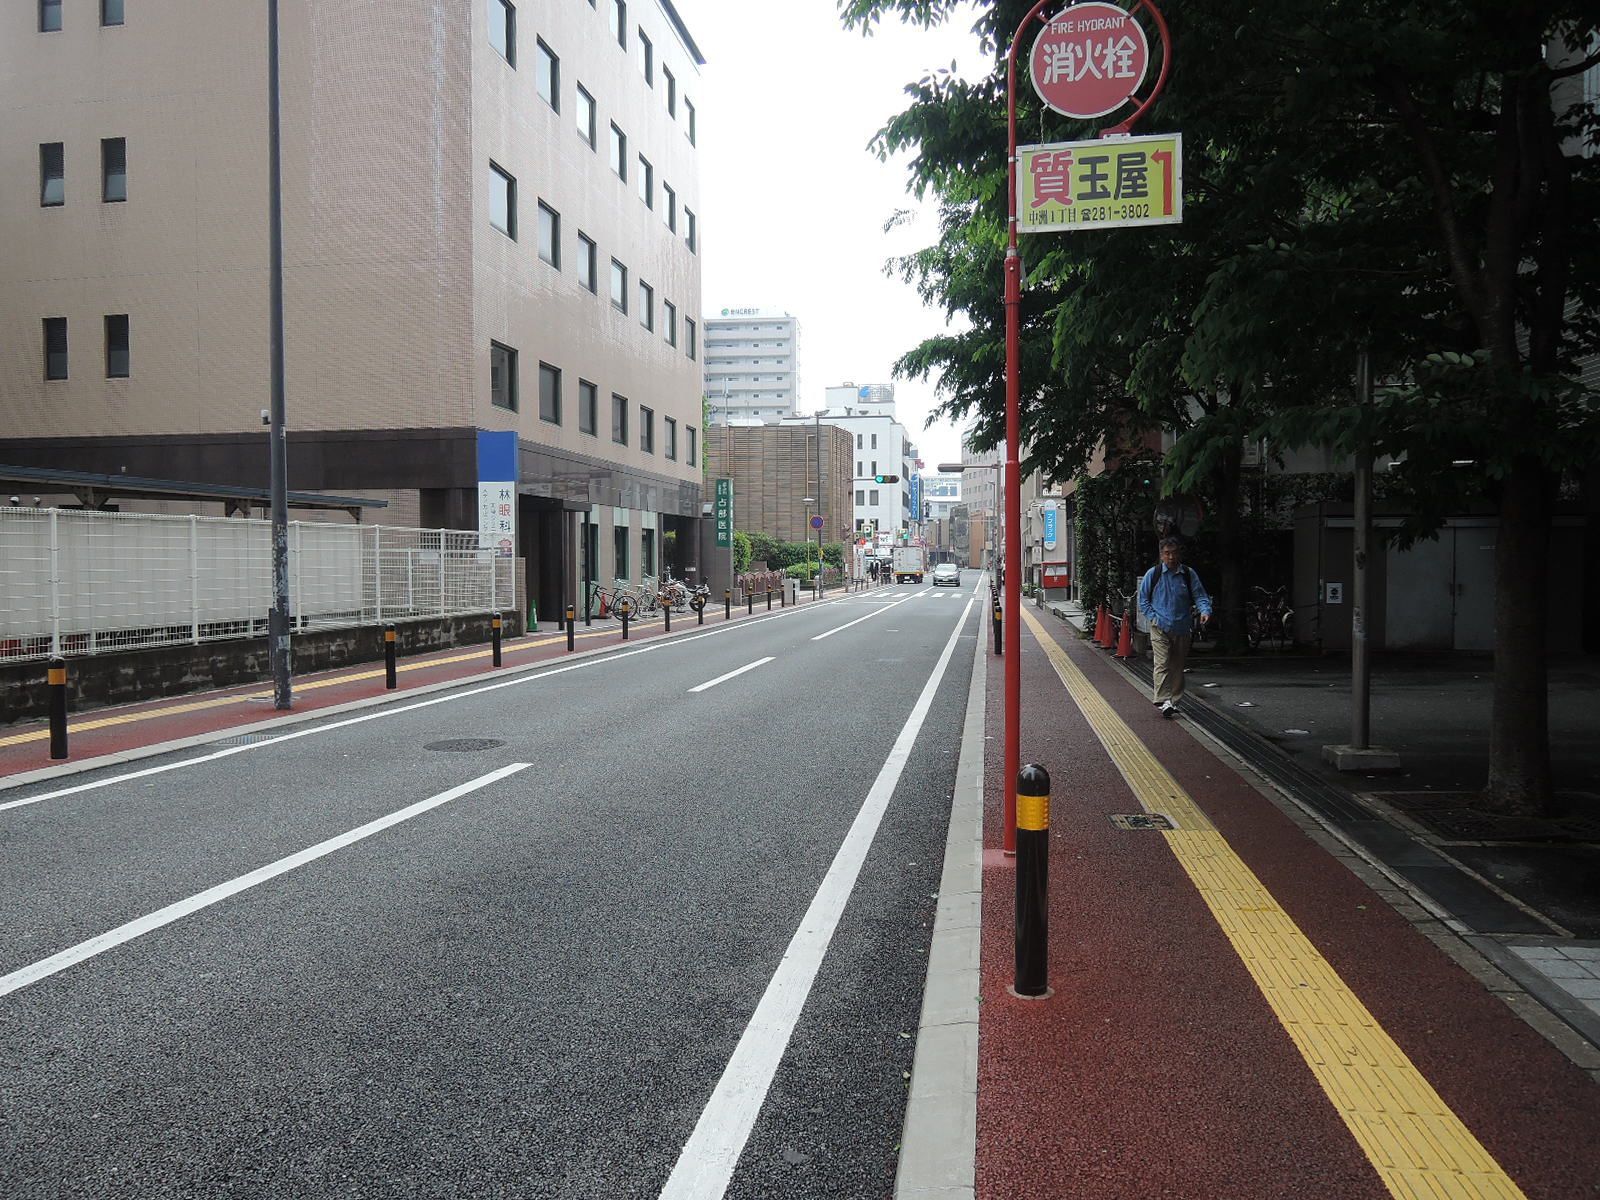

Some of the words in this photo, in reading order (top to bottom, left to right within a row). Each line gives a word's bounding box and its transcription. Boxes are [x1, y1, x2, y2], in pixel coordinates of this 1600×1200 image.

[1051, 21, 1074, 35] FIRE
[1077, 16, 1127, 33] HYDRANT
[1042, 35, 1138, 85] 消火栓
[499, 488, 511, 532] 林眼科
[718, 498, 728, 541] 占部医院
